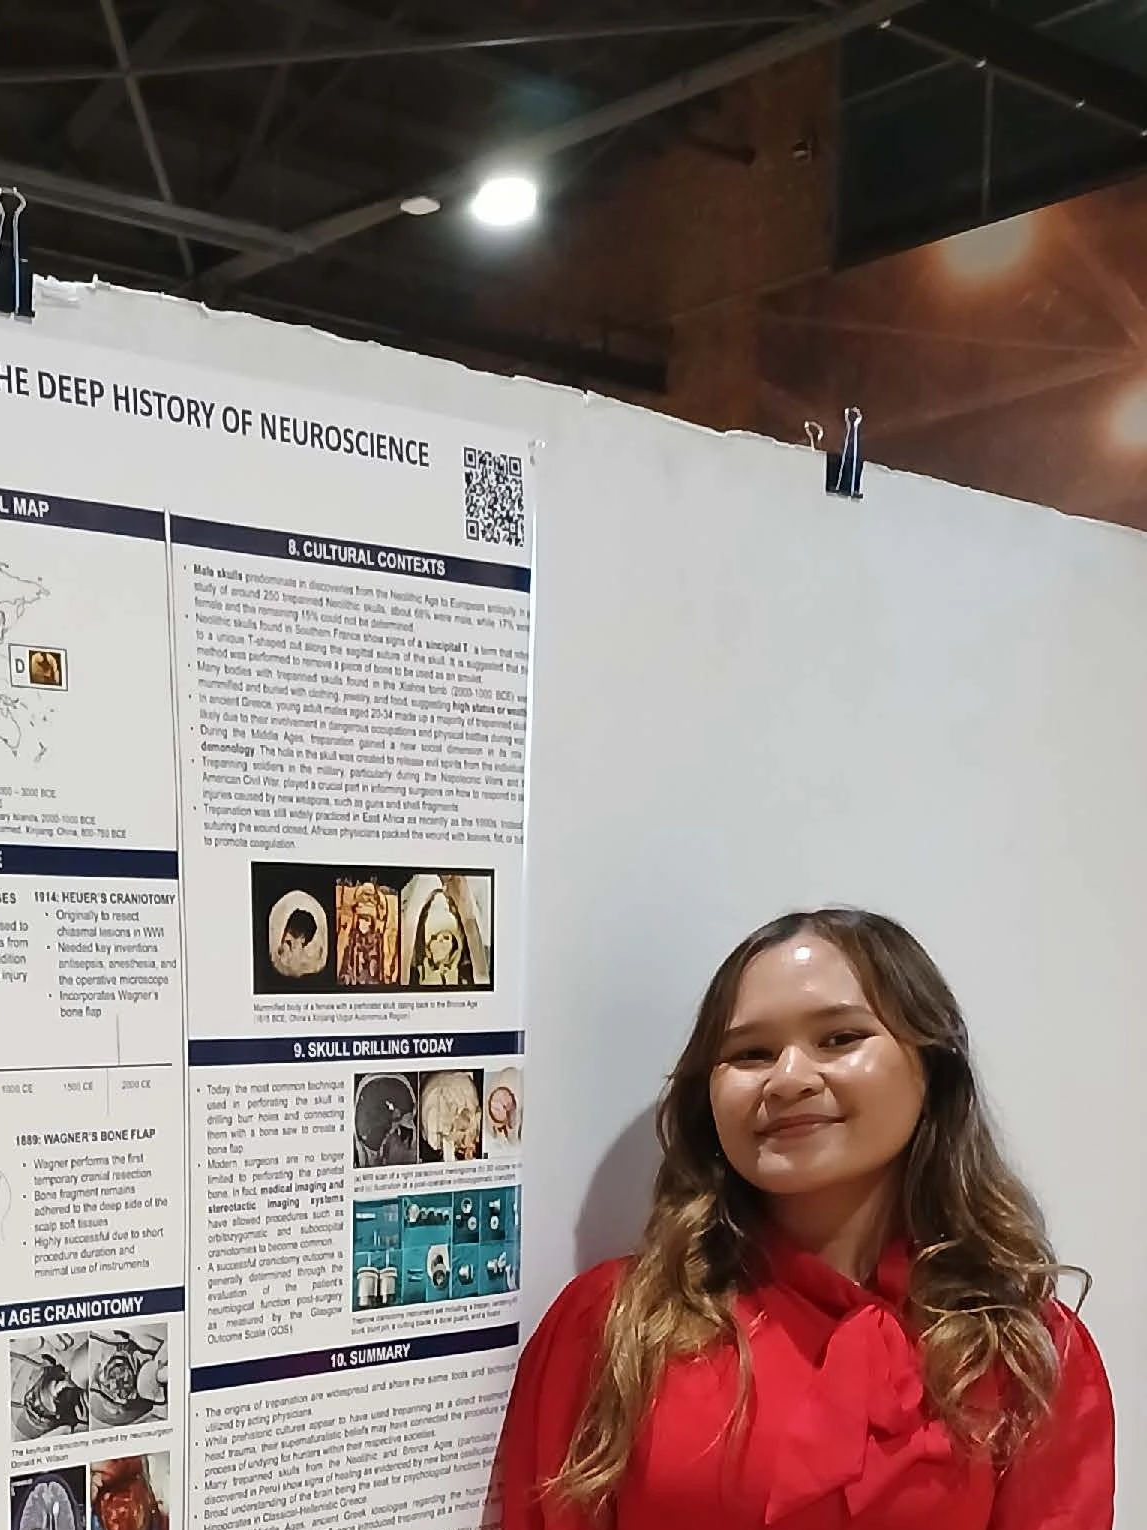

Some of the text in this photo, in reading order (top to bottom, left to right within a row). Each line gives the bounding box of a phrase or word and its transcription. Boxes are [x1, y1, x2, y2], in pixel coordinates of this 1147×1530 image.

[38, 371, 104, 406] DEEP
[113, 384, 215, 428] HISTORY
[222, 406, 252, 436] OF
[261, 413, 429, 467] NEUROSCIENCE
[13, 497, 49, 517] MAP
[289, 539, 445, 576] 8. CULTURAL CONTEXTS
[15, 658, 25, 674] D
[35, 892, 175, 904] 1914: HEUER'S CRANIOTOMY
[294, 1038, 453, 1057] 9. SKULL DRILLING TODAY
[17, 1129, 155, 1146] 1889: WAGNER'S BONE FLAP
[208, 1195, 344, 1213] stereotactic imaging systems
[9, 1307, 41, 1326] AGE
[44, 1296, 146, 1322] CRANIOTOMY
[331, 1343, 413, 1368] 10. SUMMARY
